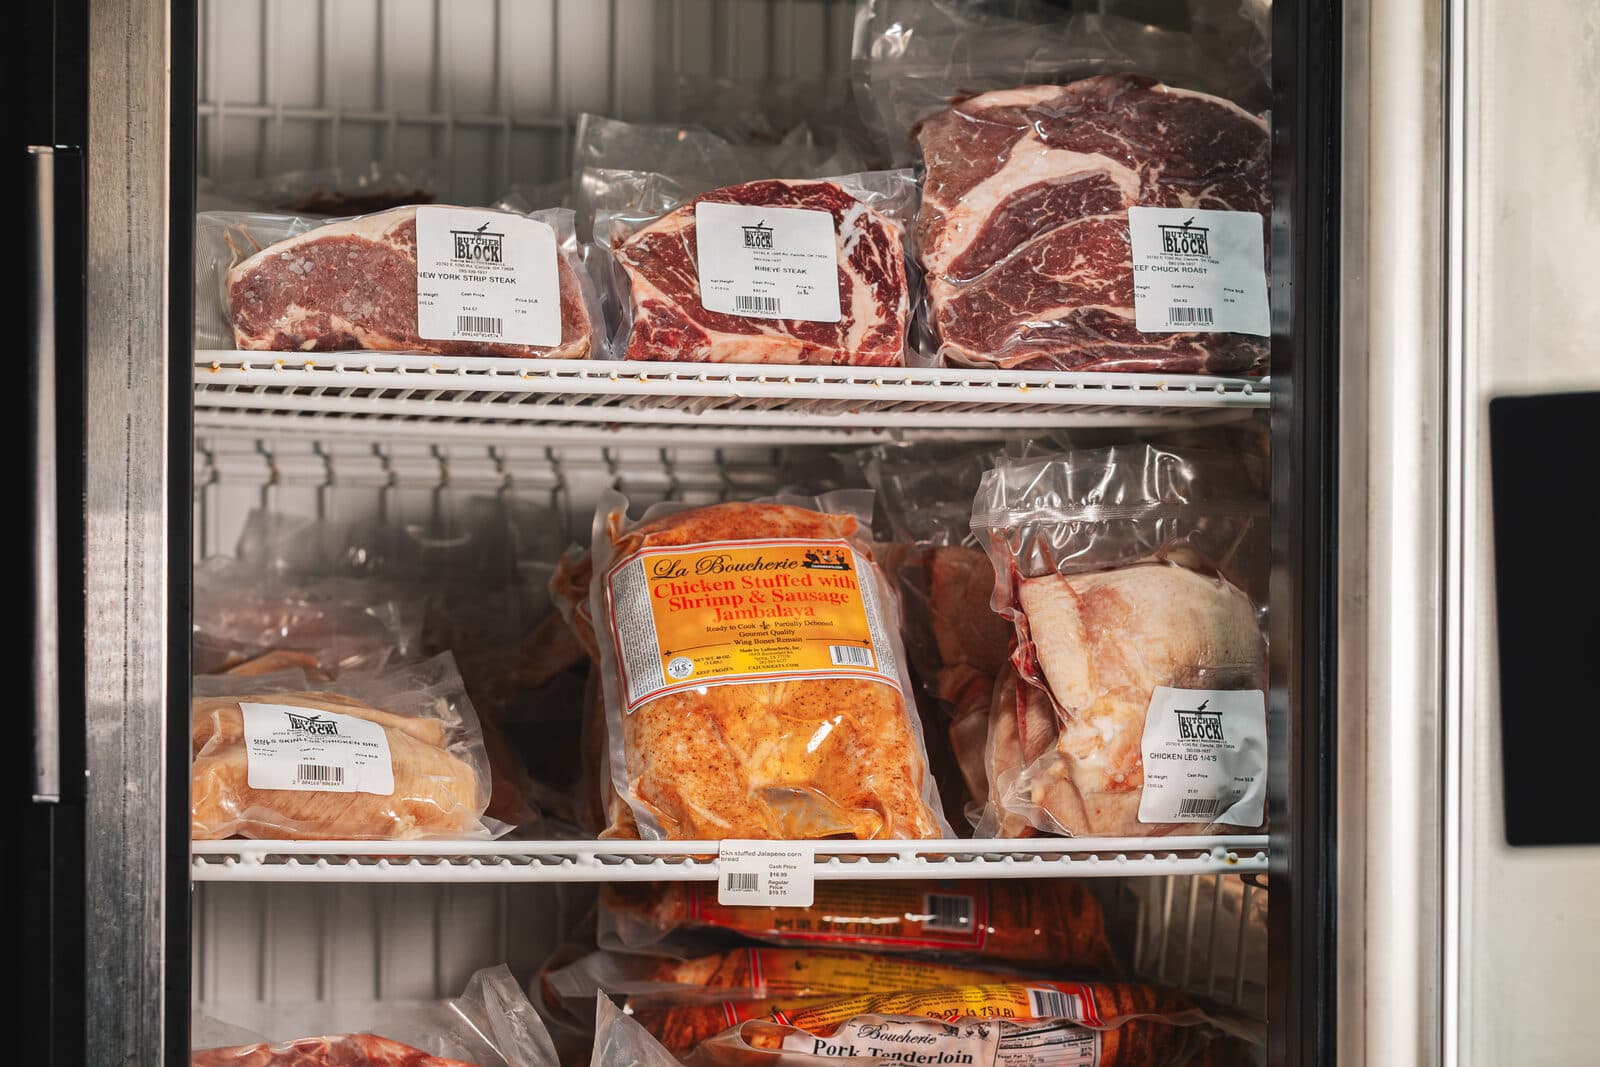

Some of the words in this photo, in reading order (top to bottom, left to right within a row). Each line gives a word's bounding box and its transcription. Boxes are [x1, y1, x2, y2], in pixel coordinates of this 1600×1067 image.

[457, 237, 500, 247] BUTCHER
[746, 235, 772, 248] BLOCK
[1165, 231, 1205, 241] BUTCHER
[458, 245, 500, 262] BLOCK
[1166, 239, 1207, 255] BLOCK
[754, 265, 780, 273] RIBEYE
[782, 267, 807, 275] STEAK
[1151, 265, 1180, 273] CHUCK
[1182, 266, 1208, 274] ROAST
[417, 271, 436, 279] NEW
[438, 273, 461, 281] YORK
[489, 276, 517, 284] STEAK
[651, 558, 688, 580] La
[696, 555, 800, 575] Boucherie
[654, 578, 735, 599] Chicken
[742, 574, 813, 590] Stuffed
[818, 576, 856, 591] with
[669, 594, 743, 612] Shrimp
[748, 590, 766, 604] &
[771, 589, 850, 606] Sausage
[713, 604, 816, 624] Jambalaya
[706, 625, 728, 633] Ready
[774, 620, 802, 628] Partially
[738, 629, 769, 638] Gourmet
[770, 629, 796, 637] Quality
[734, 638, 753, 646] Wing
[1181, 716, 1219, 726] BUTCHER
[1182, 724, 1221, 740] BLOCK
[321, 739, 361, 747] CHICKEN
[1149, 752, 1183, 761] CHICKEN
[857, 1022, 937, 1046] Boucherie
[813, 1039, 860, 1057] Pork
[868, 1047, 973, 1065] Tenderloin
